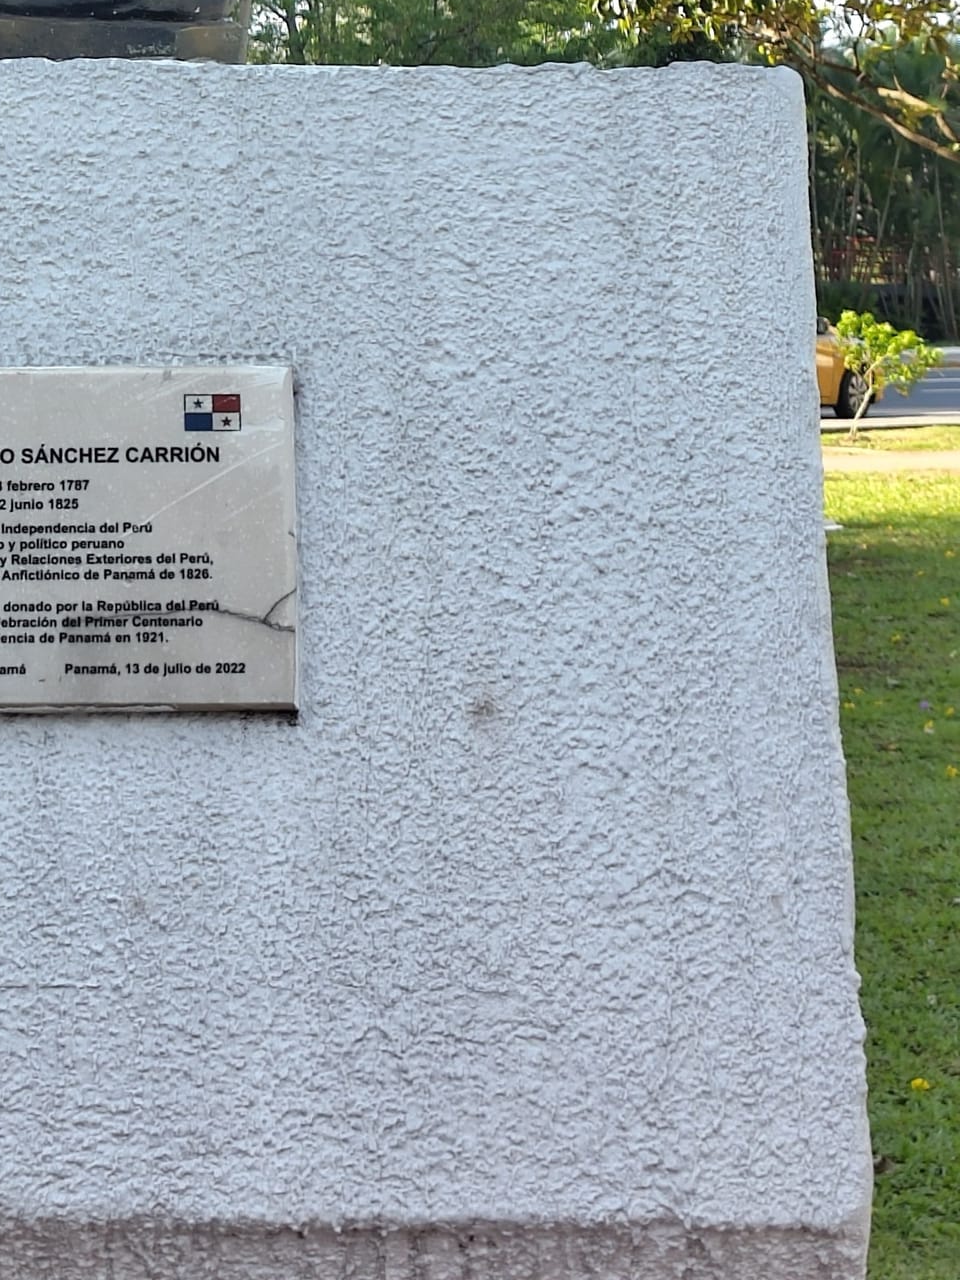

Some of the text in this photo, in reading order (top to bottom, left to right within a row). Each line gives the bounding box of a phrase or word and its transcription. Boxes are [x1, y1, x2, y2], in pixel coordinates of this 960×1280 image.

[20, 443, 120, 465] SÁNCHEZ
[125, 441, 220, 464] CARRIÓN
[6, 479, 56, 492] febrero
[59, 479, 90, 492] 1787
[9, 498, 44, 513] junio
[47, 497, 80, 510] 1825
[0, 522, 96, 537] Independencia
[98, 521, 120, 534] del
[122, 521, 153, 534] Perú
[7, 540, 16, 553] y
[19, 537, 68, 553] político
[71, 539, 125, 552] peruano
[0, 556, 8, 569] y
[10, 553, 83, 566] Relaciones
[85, 553, 153, 565] Exteriores
[155, 552, 176, 565] del
[179, 552, 214, 566] Perú,
[1, 568, 81, 582] Anfictiónico
[83, 568, 100, 581] de
[103, 567, 156, 580] Panamá
[158, 568, 176, 580] de
[179, 567, 213, 580] 1826.
[2, 600, 53, 613] donado
[55, 602, 79, 615] por
[81, 600, 93, 612] la
[96, 599, 162, 613] República
[165, 598, 186, 611] del
[189, 598, 220, 611] Perú
[61, 615, 82, 628] del
[84, 615, 129, 628] Primer
[131, 615, 204, 628] Centenario
[38, 632, 55, 644] de
[58, 631, 112, 644] Panamá
[114, 634, 131, 644] en
[135, 631, 169, 644] 1921.
[64, 662, 247, 678] Panamá, 13 de julio de 2022
